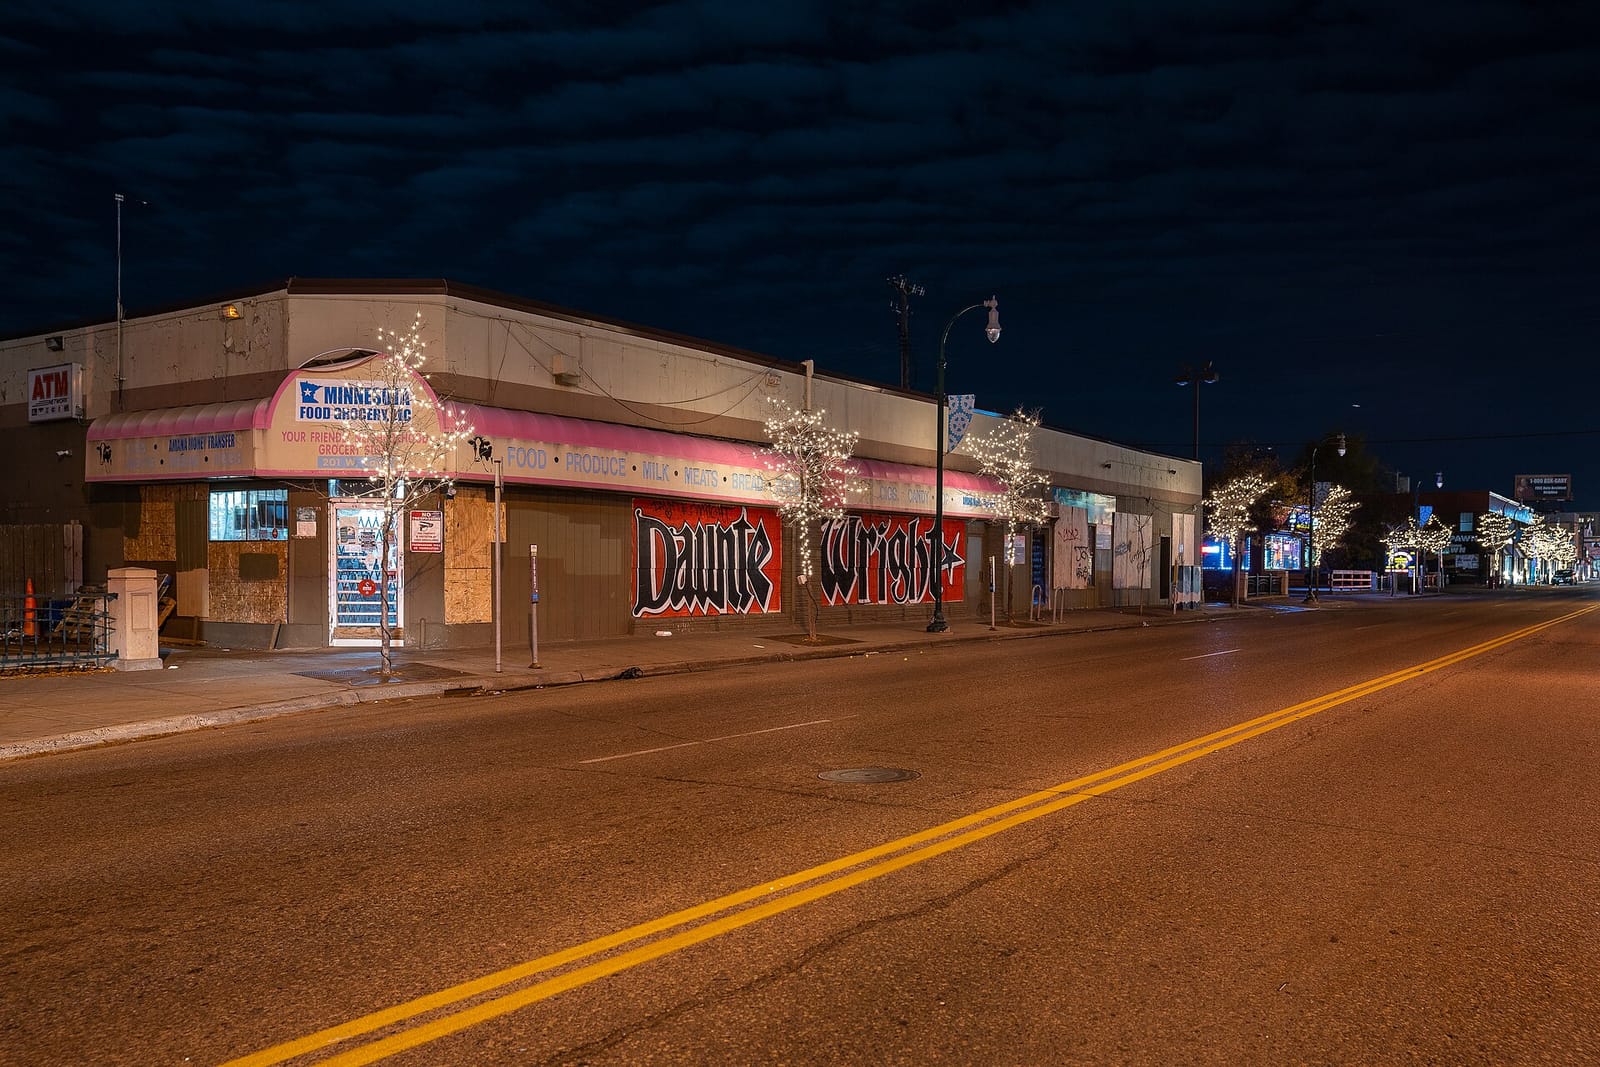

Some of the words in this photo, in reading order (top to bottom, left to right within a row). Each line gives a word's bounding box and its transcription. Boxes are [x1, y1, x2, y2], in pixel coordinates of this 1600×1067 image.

[32, 371, 69, 400] ATM
[324, 386, 410, 406] MINNESOTA
[300, 407, 331, 420] FOOD
[208, 433, 235, 449] TRANSFER
[282, 431, 306, 442] YOUR
[310, 431, 349, 443] FRIEND
[355, 432, 428, 444] NEIGHRHOOD
[319, 444, 359, 455] GROCERY
[322, 459, 341, 468] 201
[507, 447, 546, 469] FOOD
[566, 452, 626, 476] PRODUCE
[642, 461, 670, 482] MILK
[684, 466, 719, 488] MEATS
[732, 473, 763, 492] BREAD
[632, 506, 773, 617] Daunte
[821, 516, 943, 606] Wright
